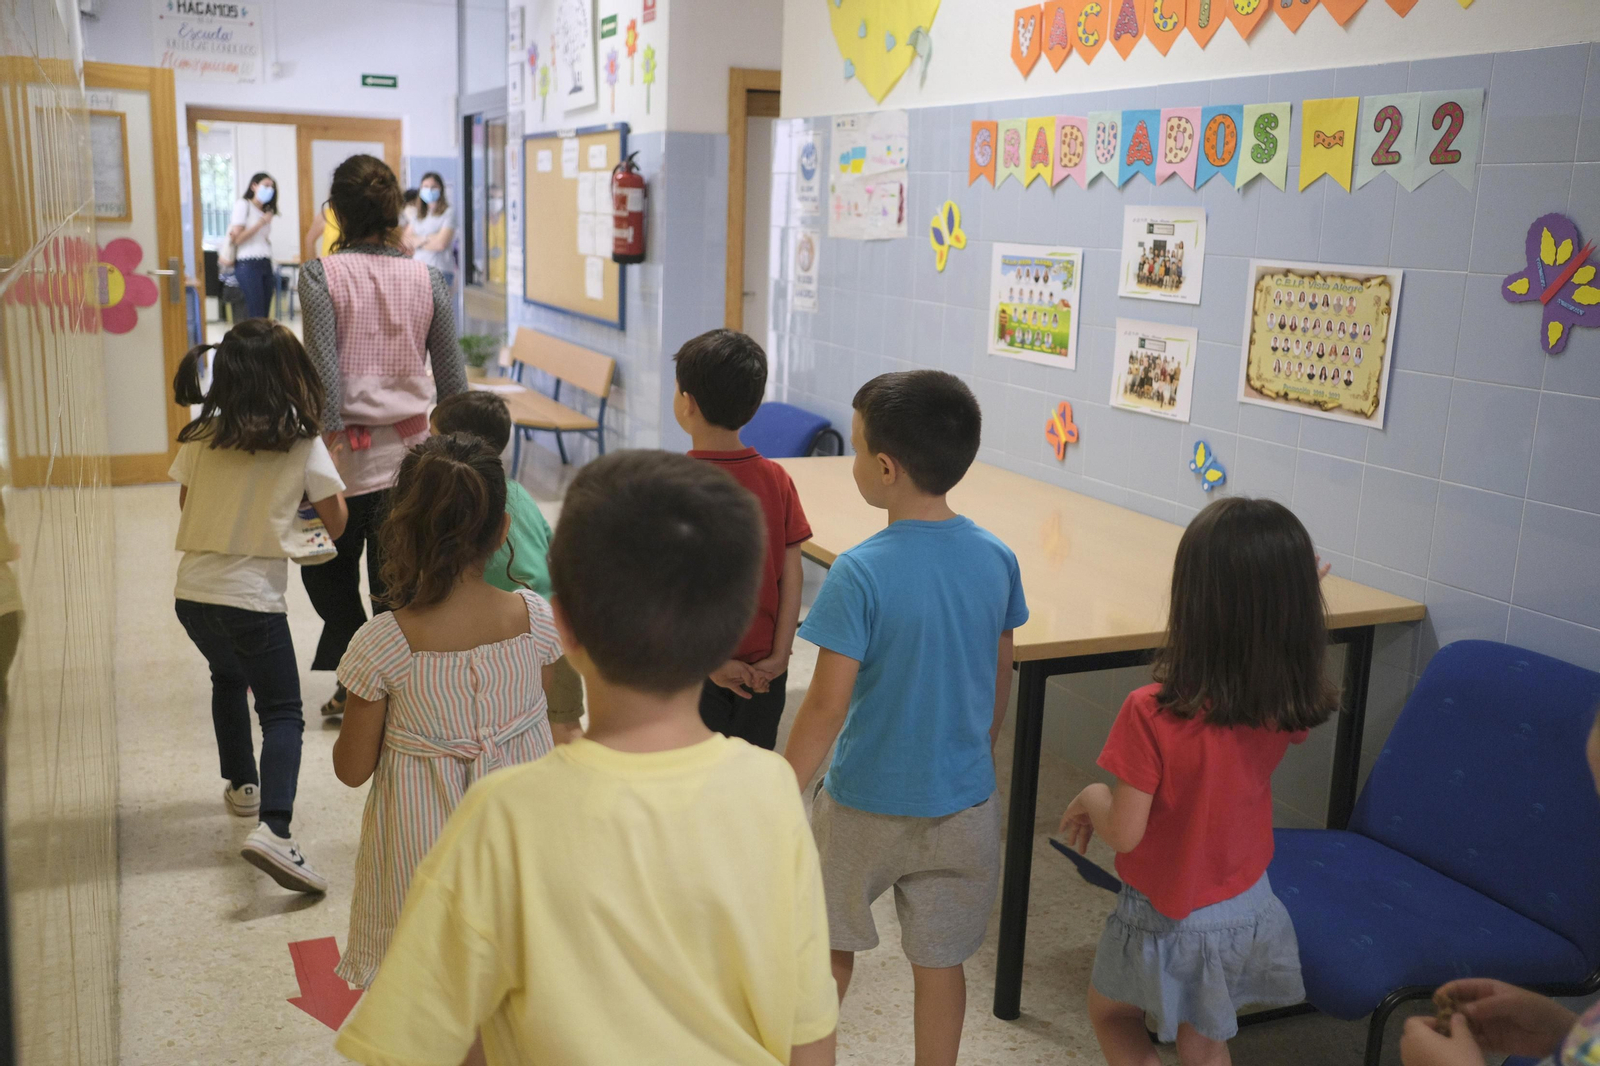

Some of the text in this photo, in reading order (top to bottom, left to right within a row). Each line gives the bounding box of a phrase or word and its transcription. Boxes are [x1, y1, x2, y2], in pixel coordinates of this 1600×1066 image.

[973, 112, 1279, 168] GRADUADOS
[1371, 101, 1462, 166] 22
[1308, 280, 1330, 290] Vista
[1333, 282, 1364, 294] Alegre
